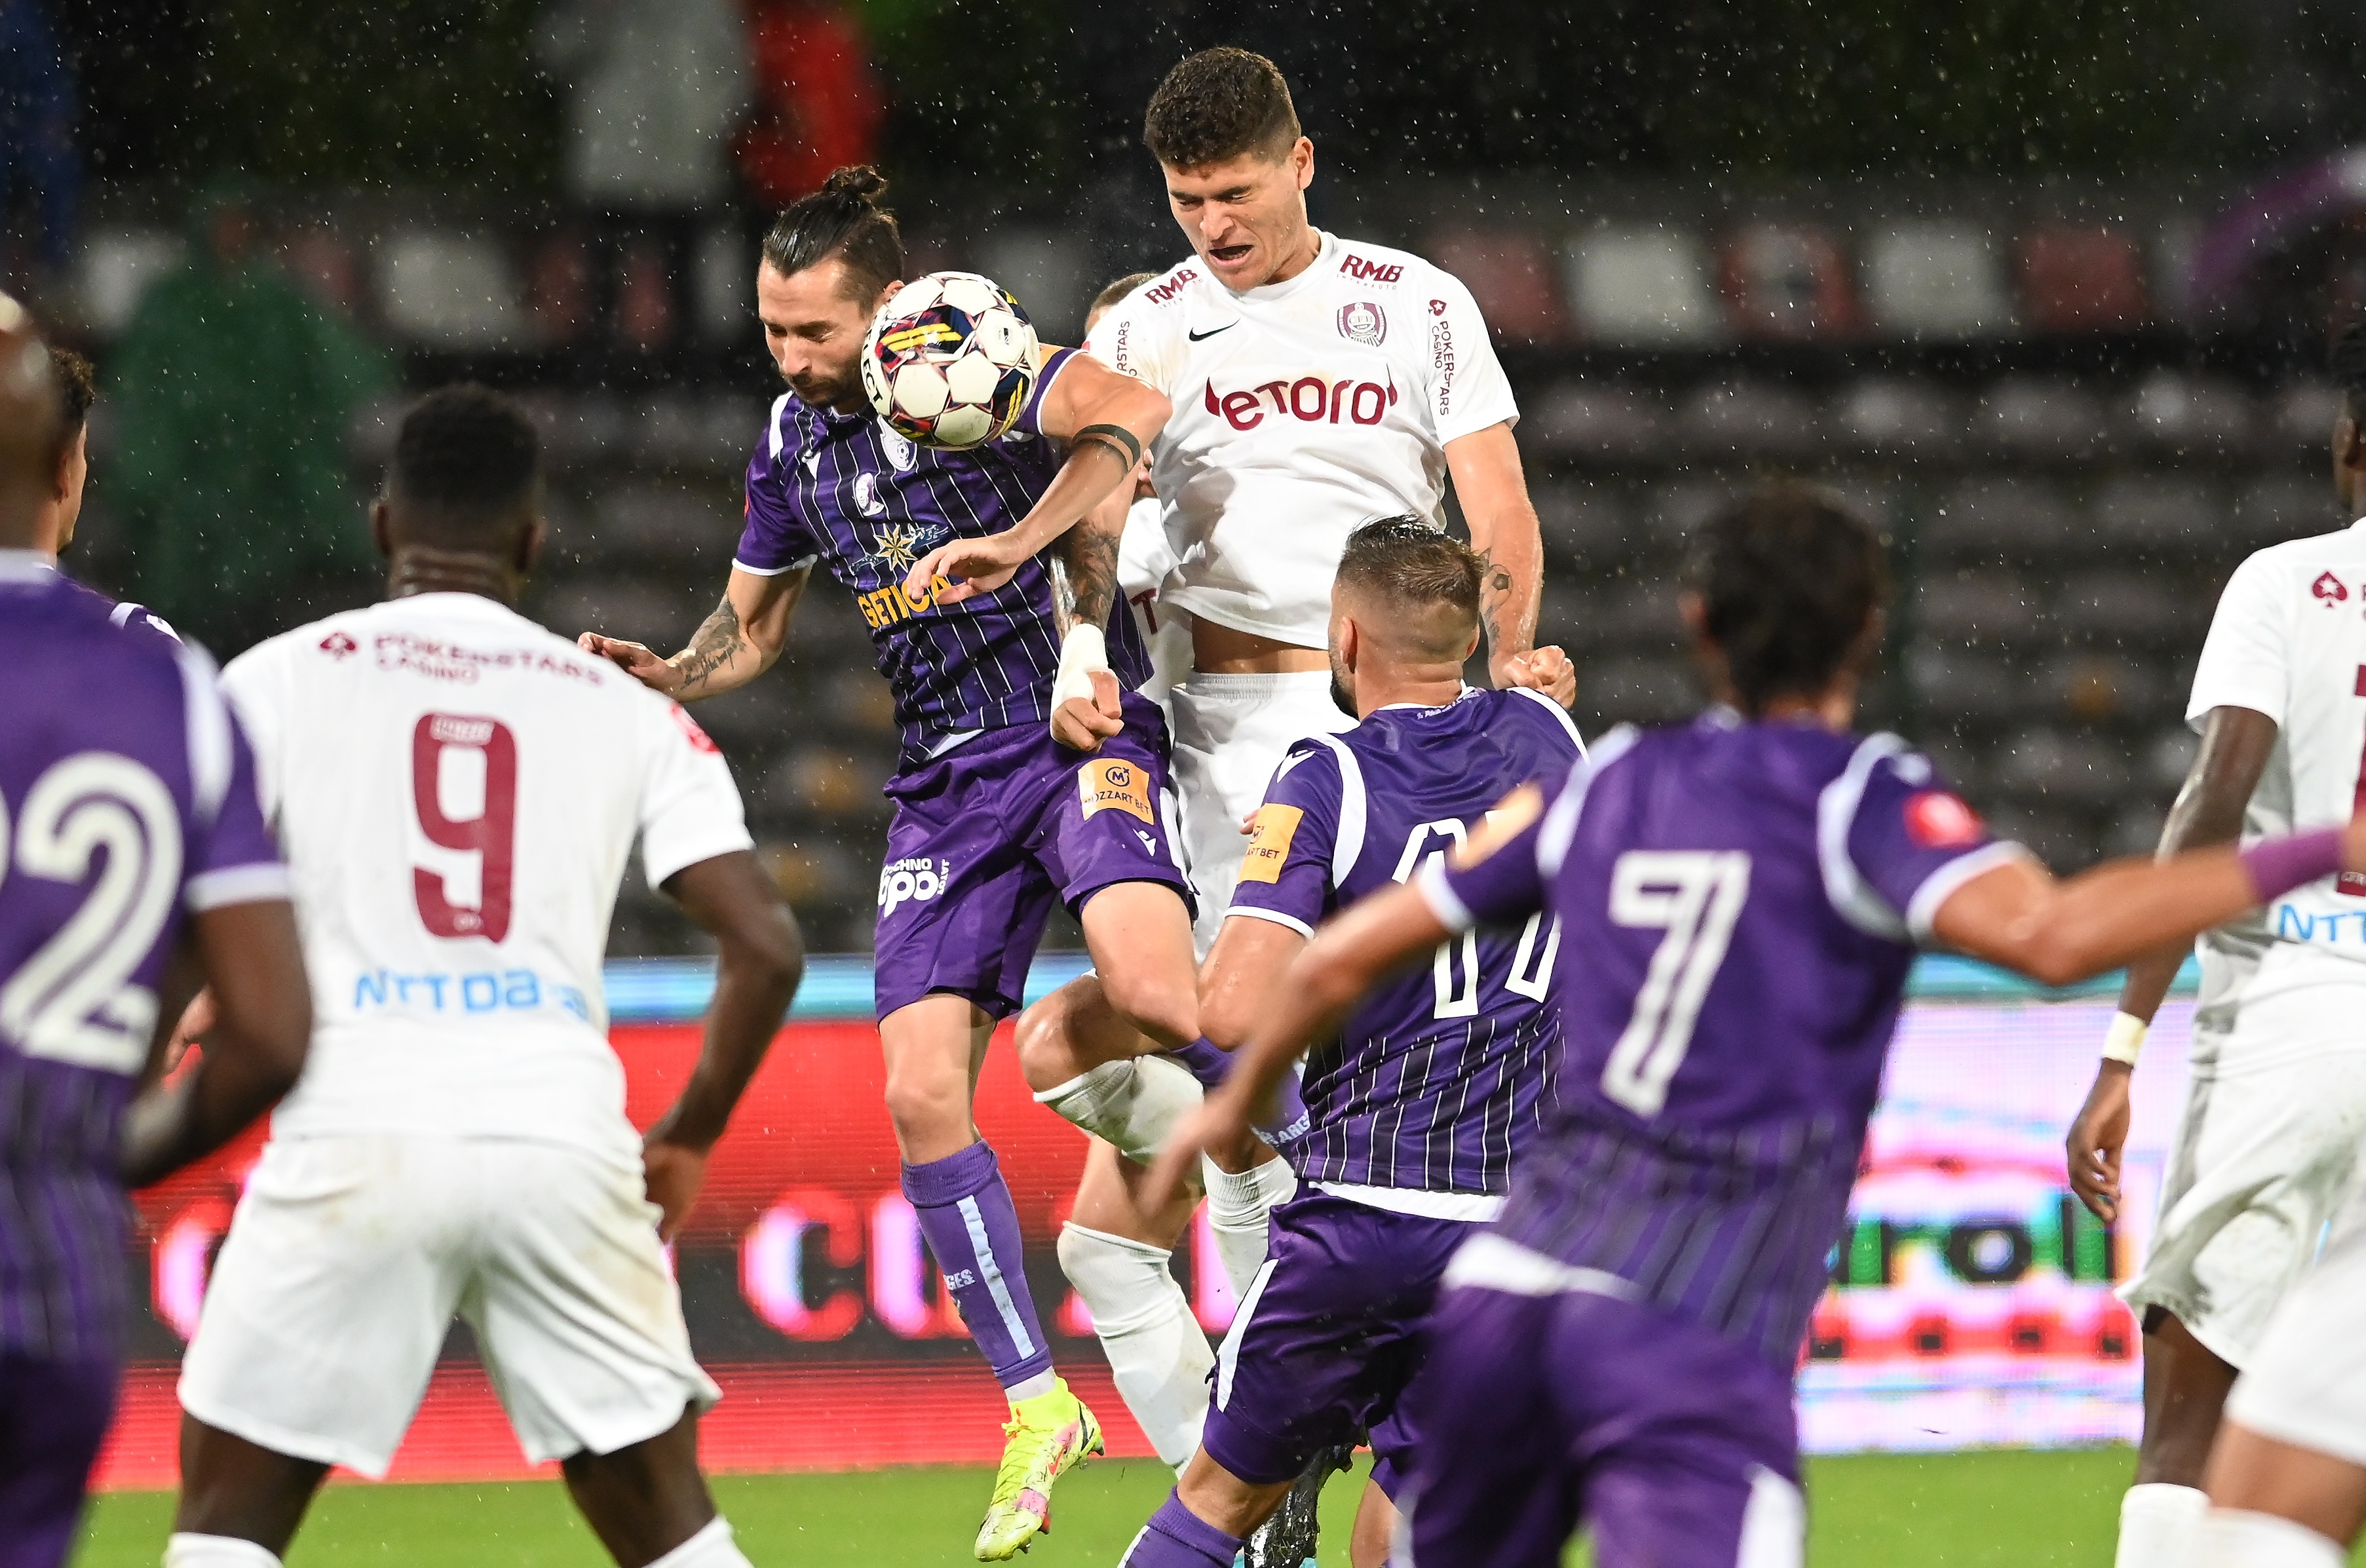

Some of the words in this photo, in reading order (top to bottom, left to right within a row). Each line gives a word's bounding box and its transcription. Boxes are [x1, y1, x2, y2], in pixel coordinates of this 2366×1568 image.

[1145, 269, 1198, 304] RMB
[1337, 273, 1397, 290] INTERAUTO
[1339, 254, 1404, 282] RMB
[1158, 278, 1204, 310] INTERTO
[1432, 325, 1443, 369] CASINO
[1440, 320, 1455, 416] POKERSTARS
[858, 573, 951, 628] GETICA
[1135, 799, 1150, 814] BET
[413, 712, 517, 944] 9
[1259, 848, 1280, 859] BET
[0, 750, 183, 1076] 2
[1600, 850, 1751, 1118] 7
